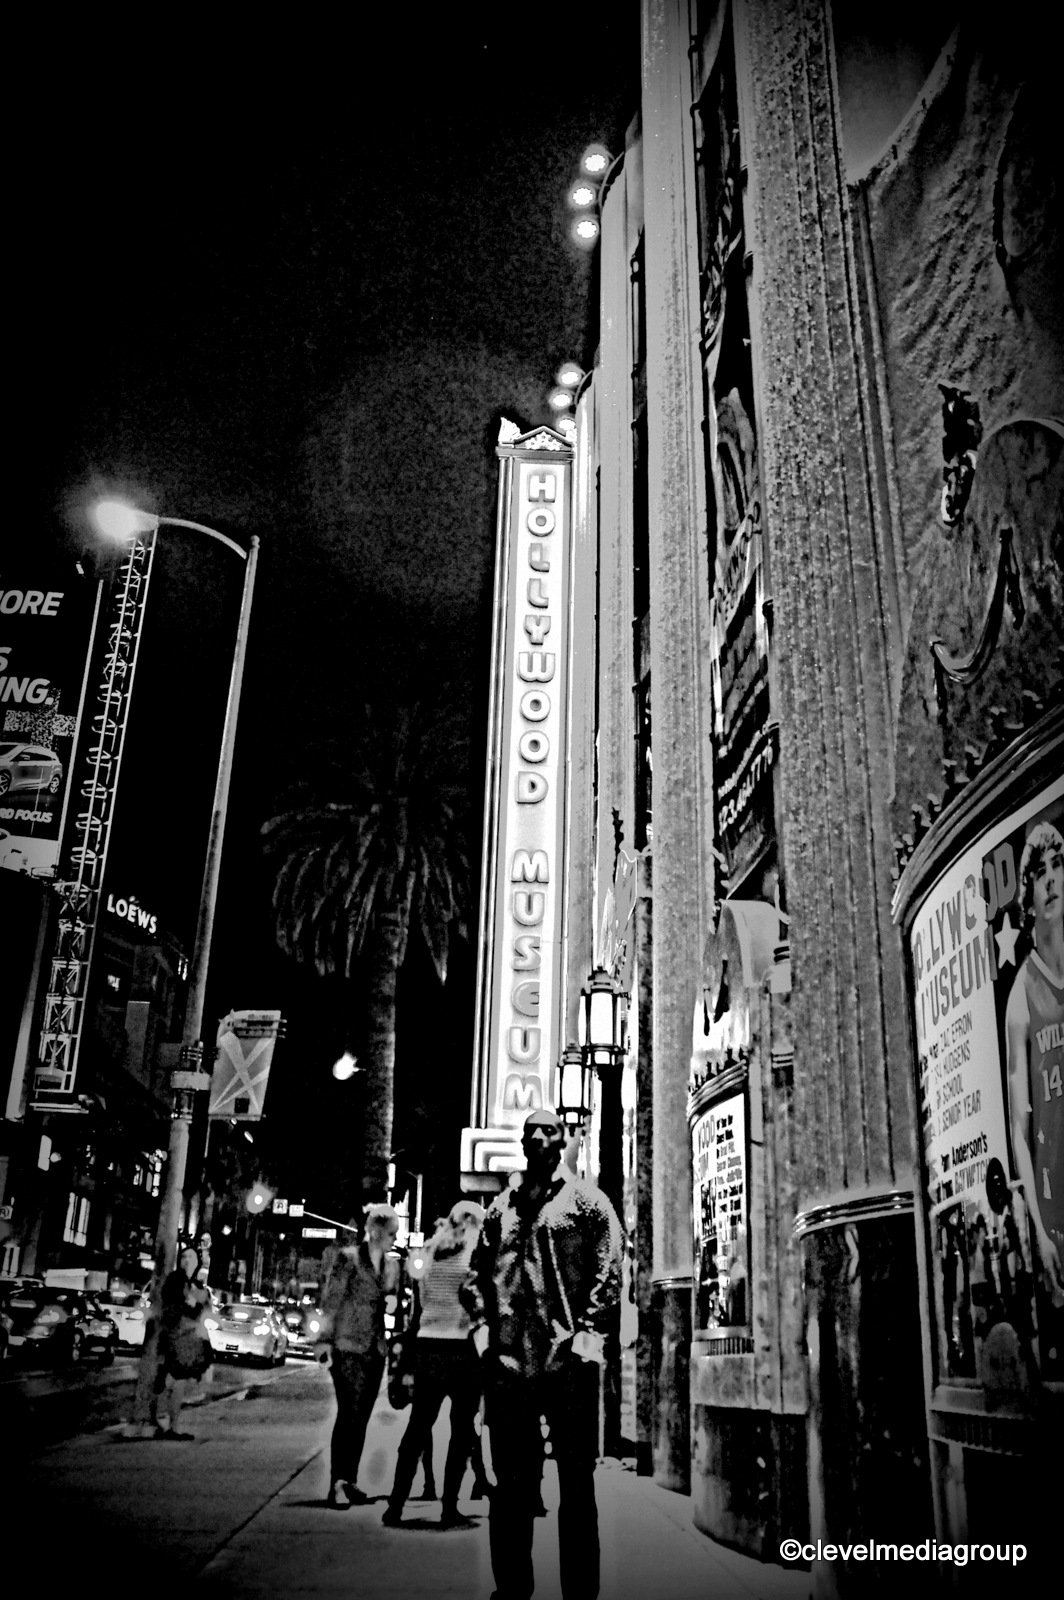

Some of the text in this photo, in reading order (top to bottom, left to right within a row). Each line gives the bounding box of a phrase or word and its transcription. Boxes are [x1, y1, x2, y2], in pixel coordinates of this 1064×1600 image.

[0, 589, 64, 616] ORE
[516, 473, 558, 804] HOLLYWOOD
[14, 808, 53, 824] FOCUS
[107, 893, 157, 934] LOEWS
[502, 848, 550, 1111] MUSEUM
[1042, 1064, 1063, 1102] 14
[963, 1088, 982, 1119] YEAR
[951, 1130, 989, 1168] Anderson's
